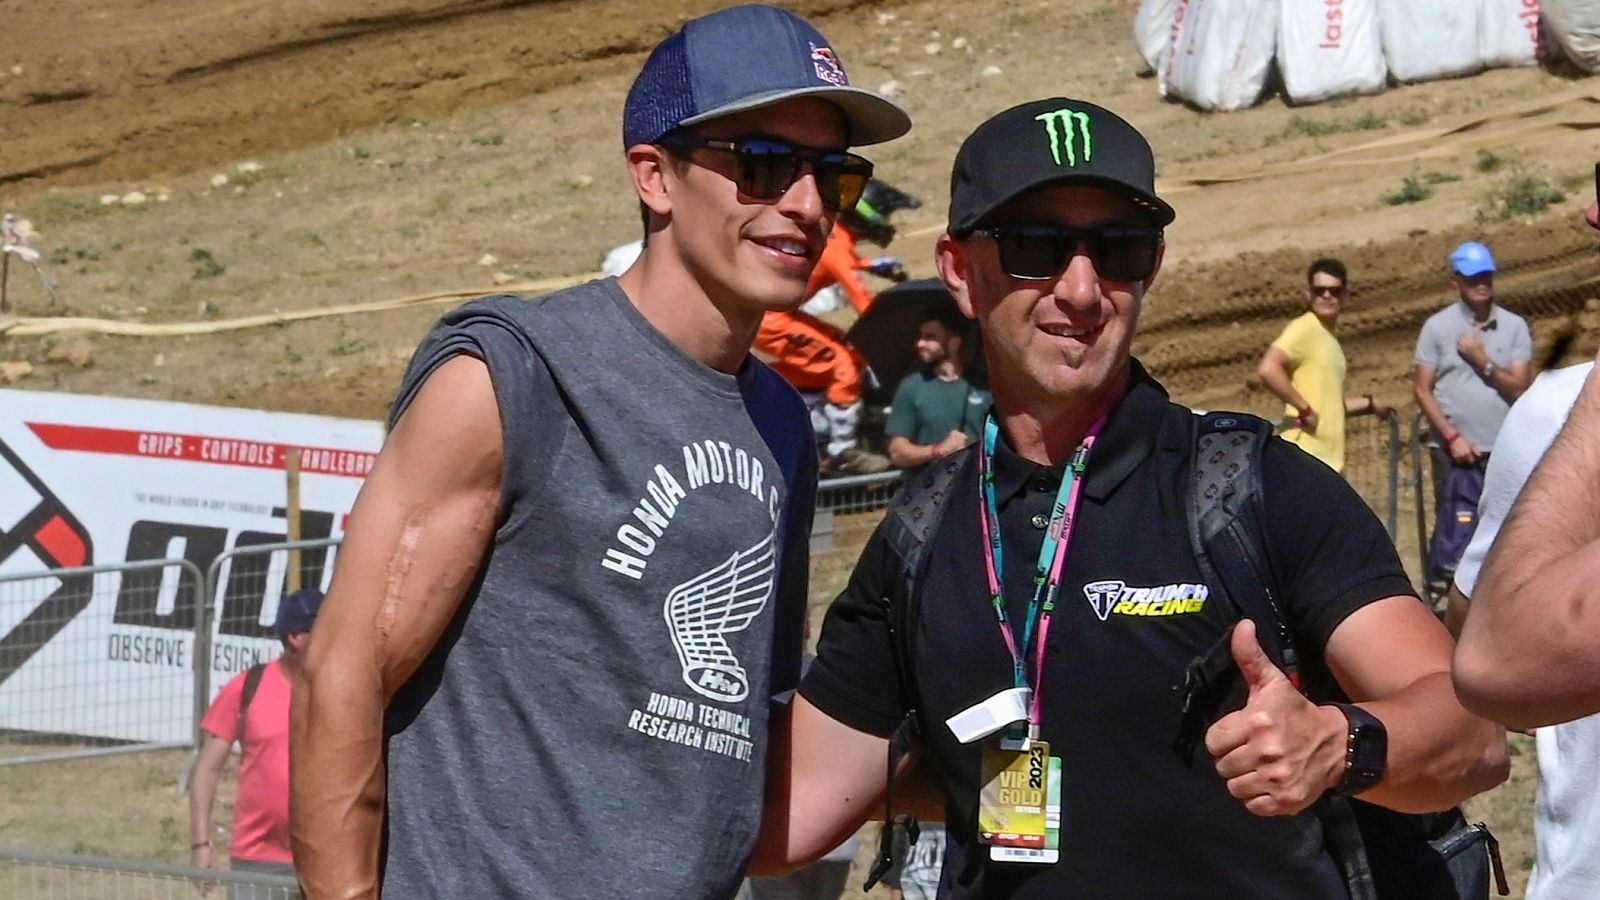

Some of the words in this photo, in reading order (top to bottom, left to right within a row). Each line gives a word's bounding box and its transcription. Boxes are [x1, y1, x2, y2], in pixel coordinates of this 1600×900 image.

[138, 433, 183, 456] GRIPS
[202, 439, 275, 465] CONTROLS
[299, 447, 376, 474] ANDLEBAR
[601, 463, 686, 580] HONDA
[682, 439, 764, 502] MOTOR
[1113, 598, 1204, 617] RACING
[1120, 583, 1209, 604] TRIUMPH
[108, 633, 185, 668] OBSERVE
[213, 643, 261, 673] ESIGN
[647, 691, 694, 722] HONDA
[698, 704, 751, 738] TECHNICAL
[627, 709, 703, 748] RESEARCH
[704, 731, 754, 762] INSTITUTE
[1000, 771, 1026, 788] VIP
[1029, 746, 1044, 789] 2023
[1000, 788, 1042, 806] GOLD
